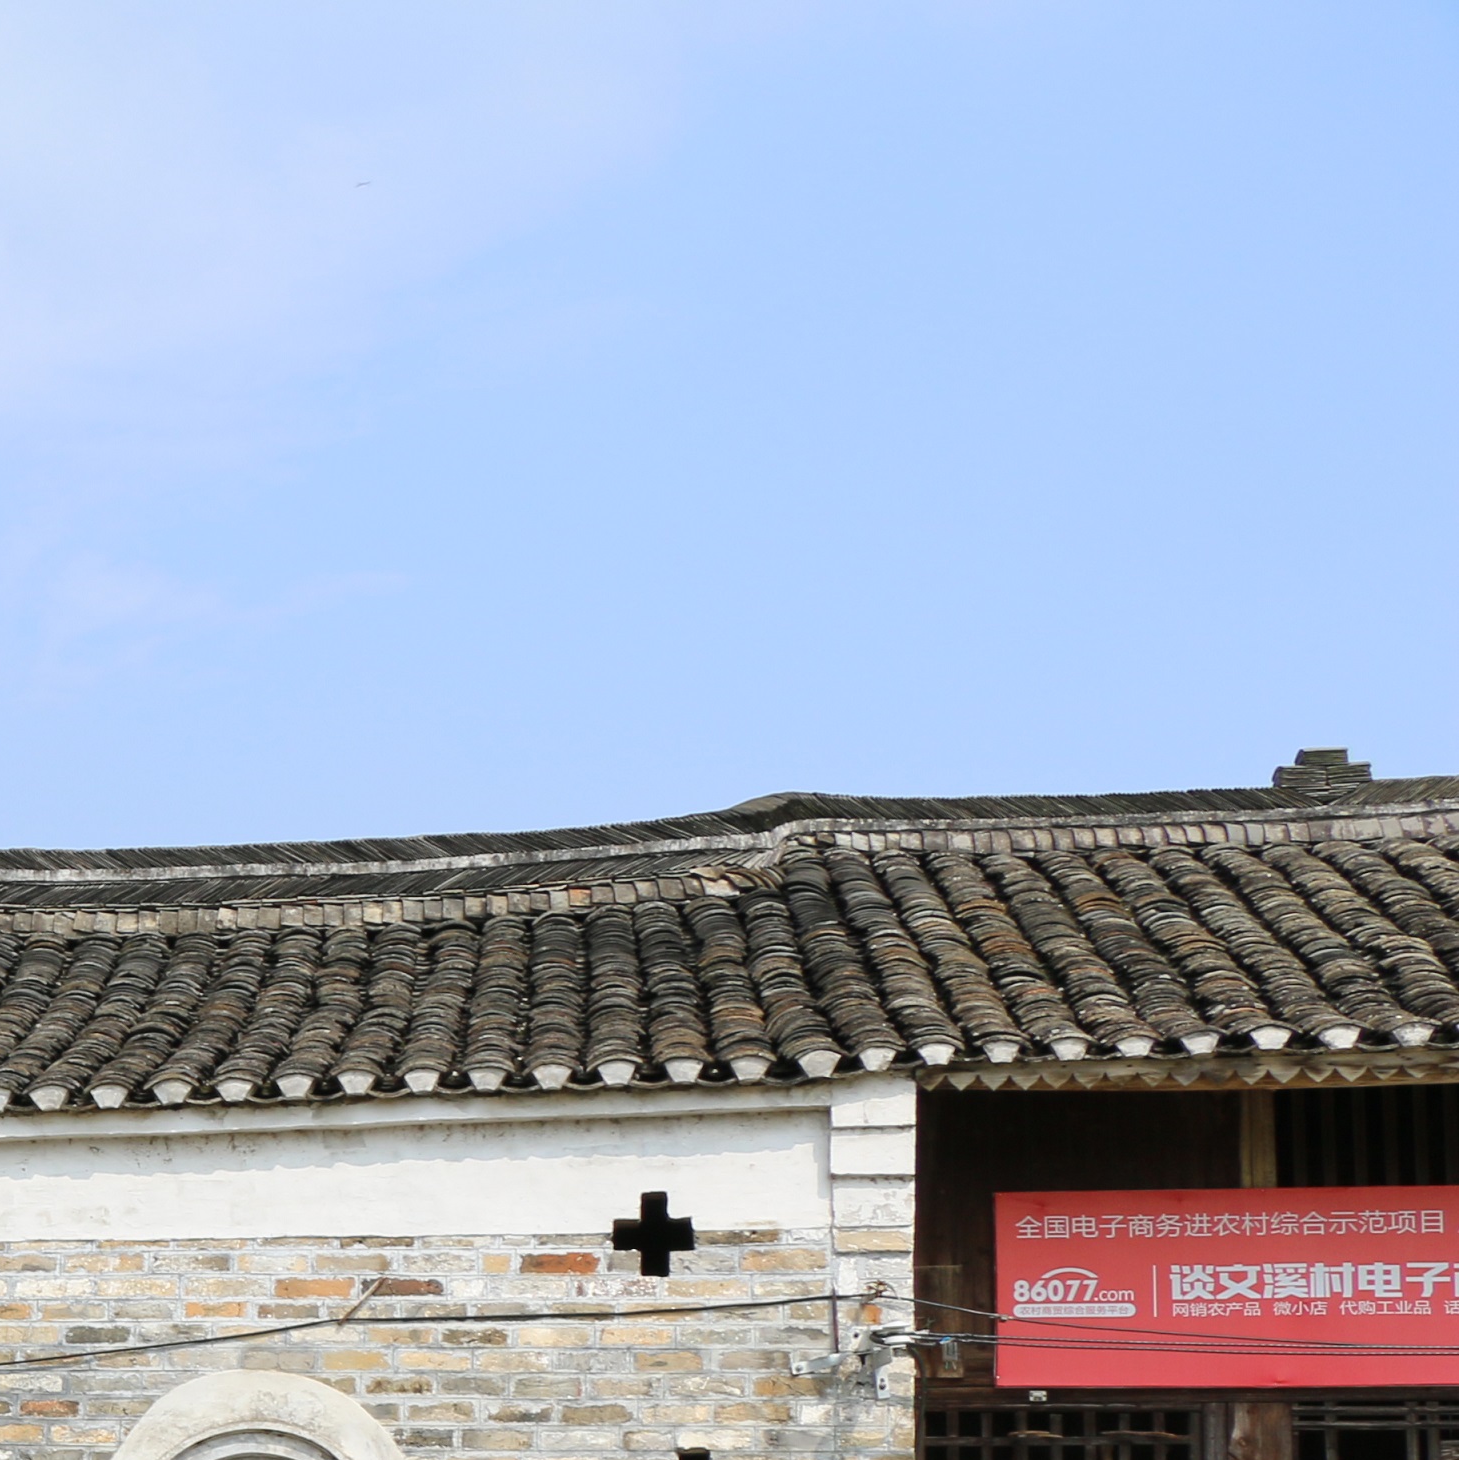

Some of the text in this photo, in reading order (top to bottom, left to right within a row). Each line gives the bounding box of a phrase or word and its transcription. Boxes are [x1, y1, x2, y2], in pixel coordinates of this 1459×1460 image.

[1015, 1209, 1445, 1239] 全国电子商务进农村综合示范项目
[1013, 1279, 1135, 1302] 86077.com
[1168, 1261, 1459, 1300] 谈文溪村电子
[1172, 1301, 1262, 1317] 网销农产品
[1273, 1301, 1328, 1316] 微小店
[1339, 1300, 1432, 1316] 代购工业品
